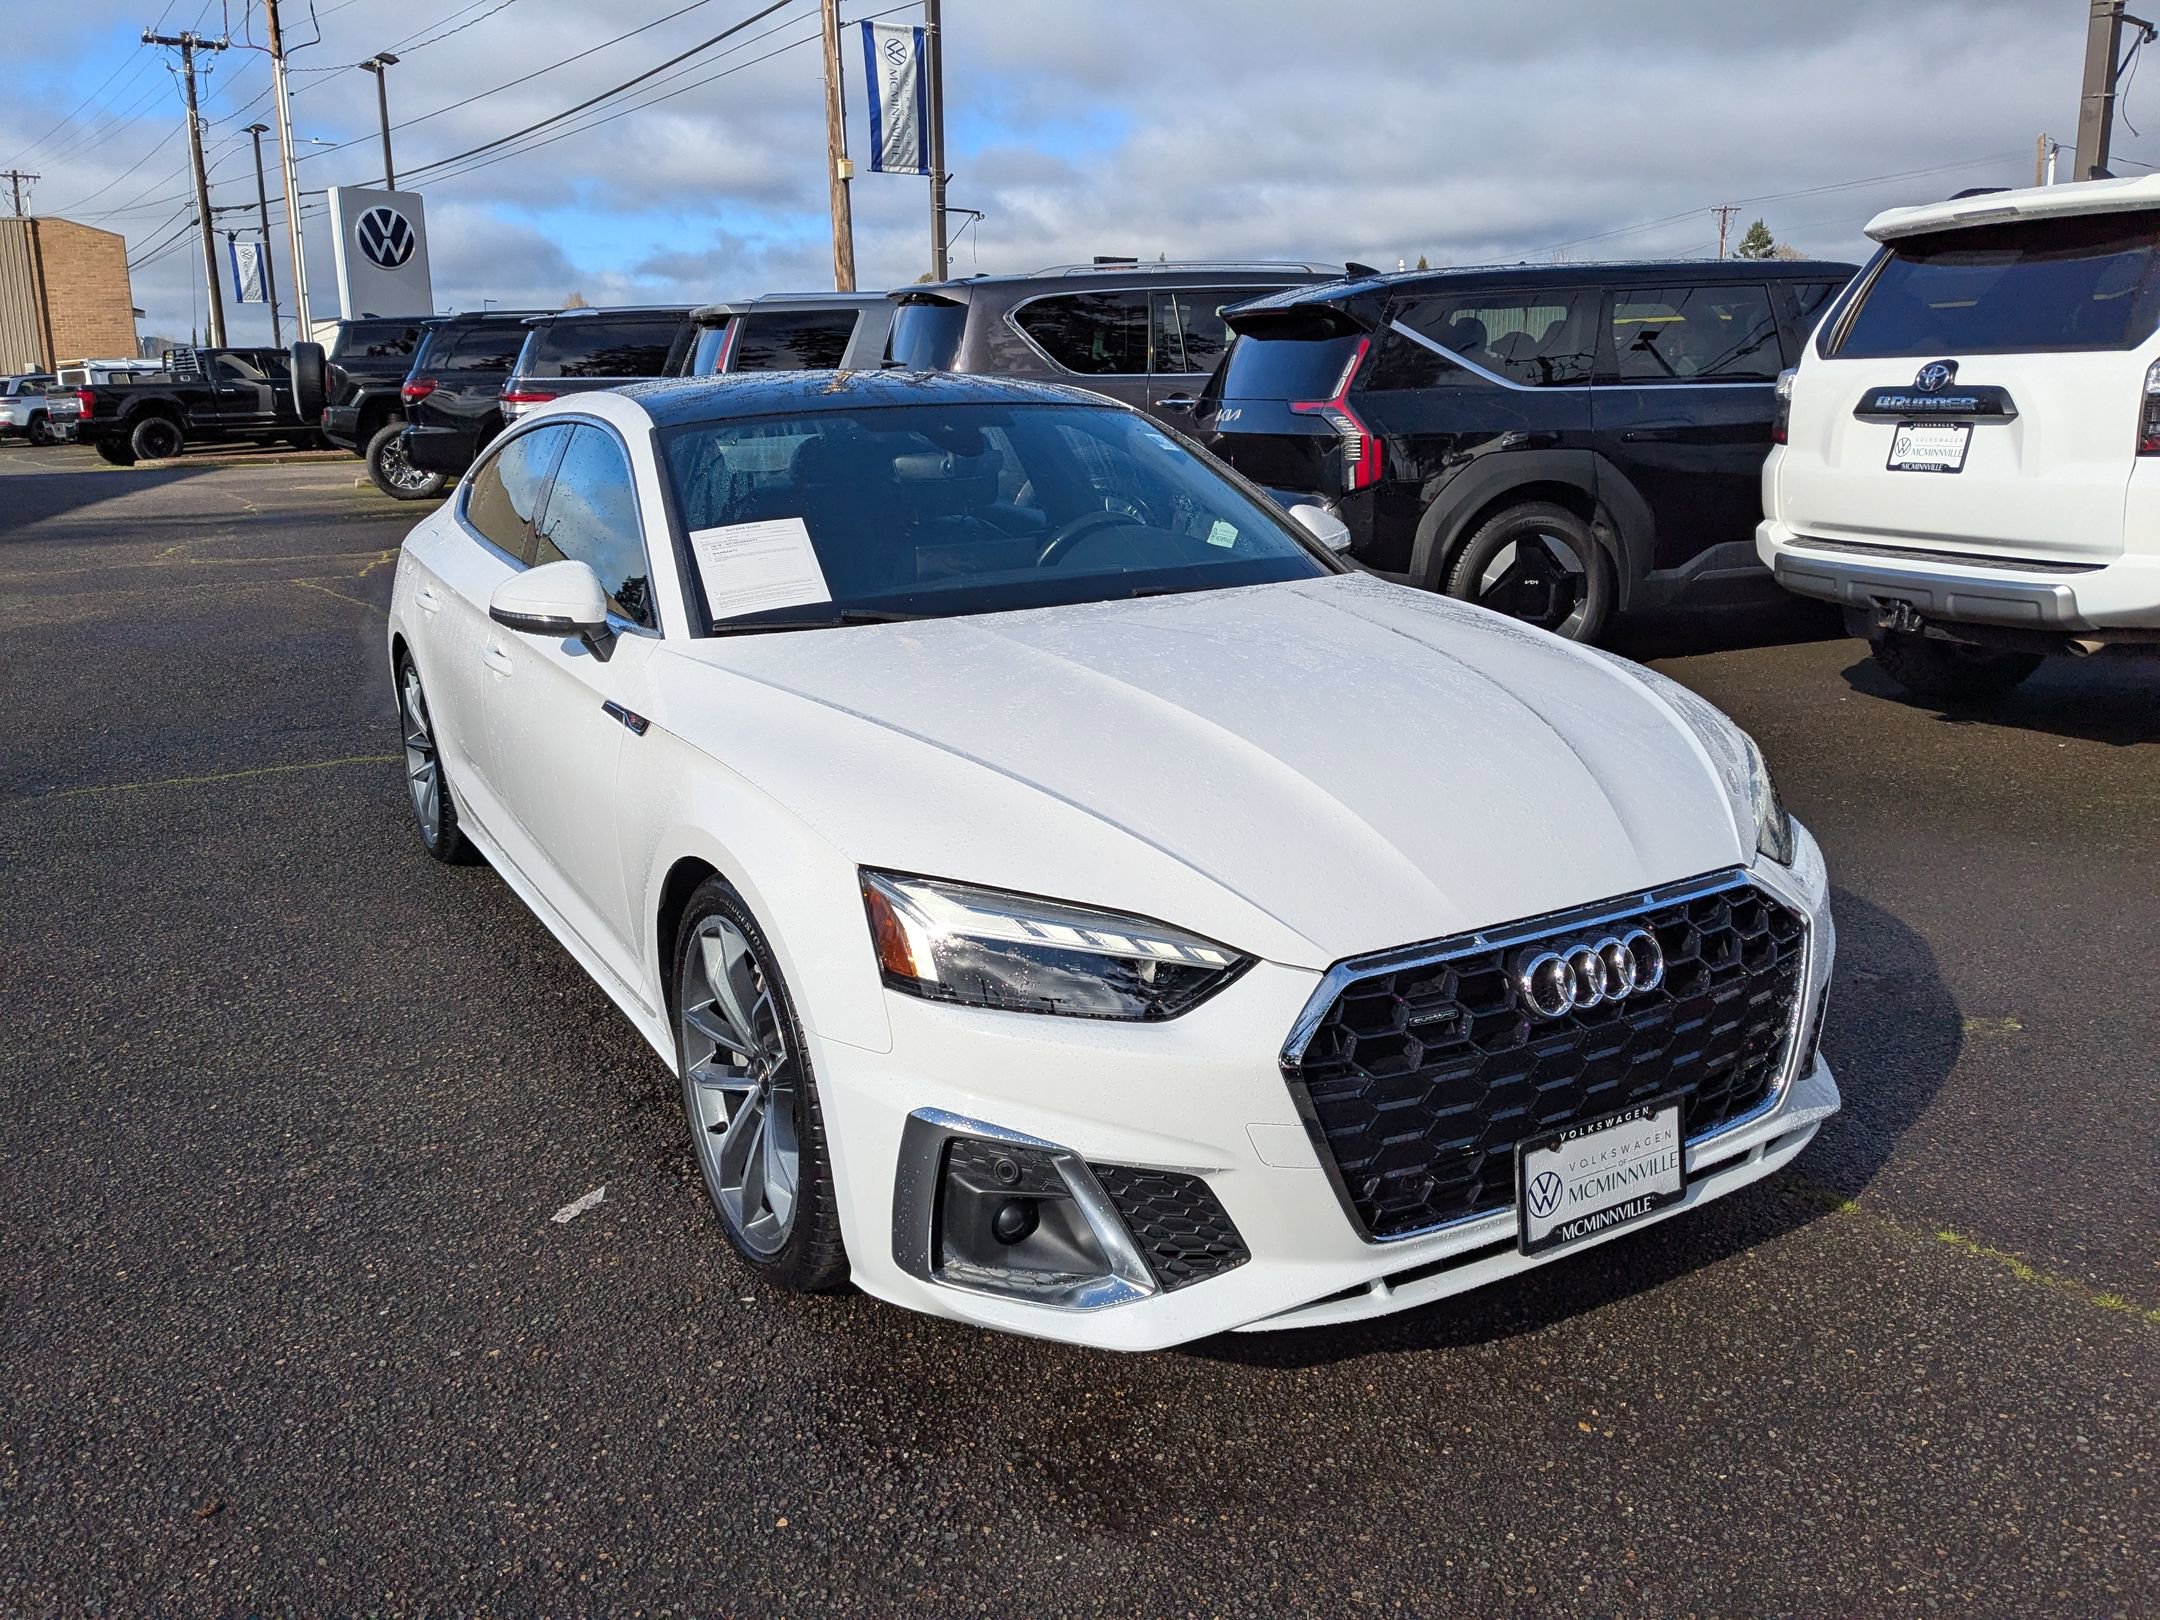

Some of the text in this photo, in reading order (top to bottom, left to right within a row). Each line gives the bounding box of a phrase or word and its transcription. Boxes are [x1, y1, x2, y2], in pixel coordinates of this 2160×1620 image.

[889, 68, 901, 160] MCMINNVILLE
[356, 206, 415, 269] VW
[1901, 462, 1944, 471] MCMINNVILLE
[1911, 448, 1963, 458] MCMINNVILLE
[1559, 1106, 1650, 1141] VOLKSWAGEN
[1569, 1129, 1672, 1172] VOLKSWAGEN
[1568, 1151, 1679, 1205] MCMINNVILLE
[1562, 1196, 1652, 1242] MCMINNVILLE
